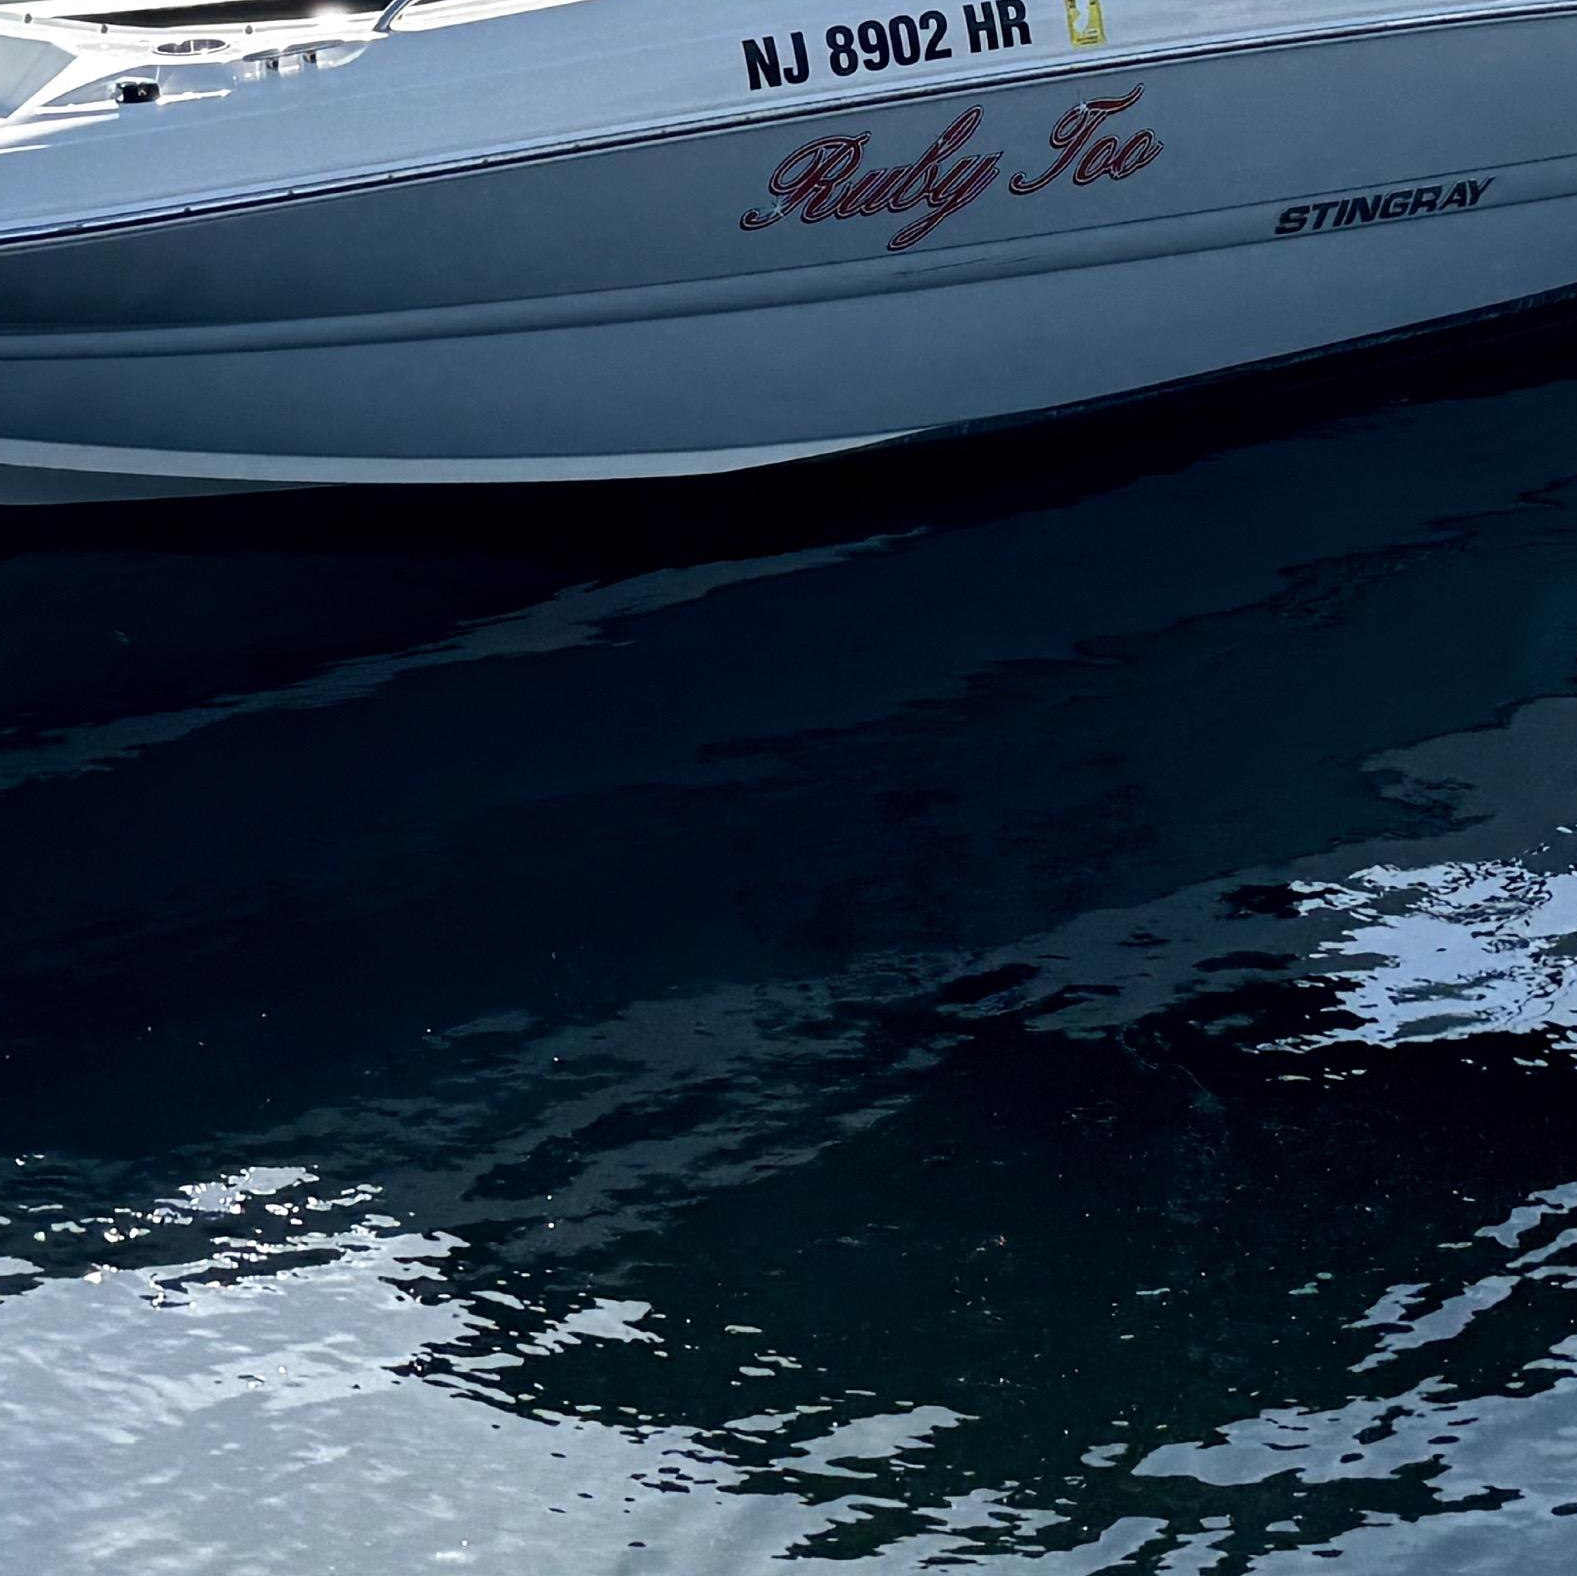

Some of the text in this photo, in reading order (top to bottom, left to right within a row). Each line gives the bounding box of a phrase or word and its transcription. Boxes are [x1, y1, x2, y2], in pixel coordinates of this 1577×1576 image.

[742, 31, 810, 91] NJ
[826, 10, 952, 77] 8902
[739, 83, 1165, 252] Ruby Too
[1275, 176, 1495, 236] STINGRAY
